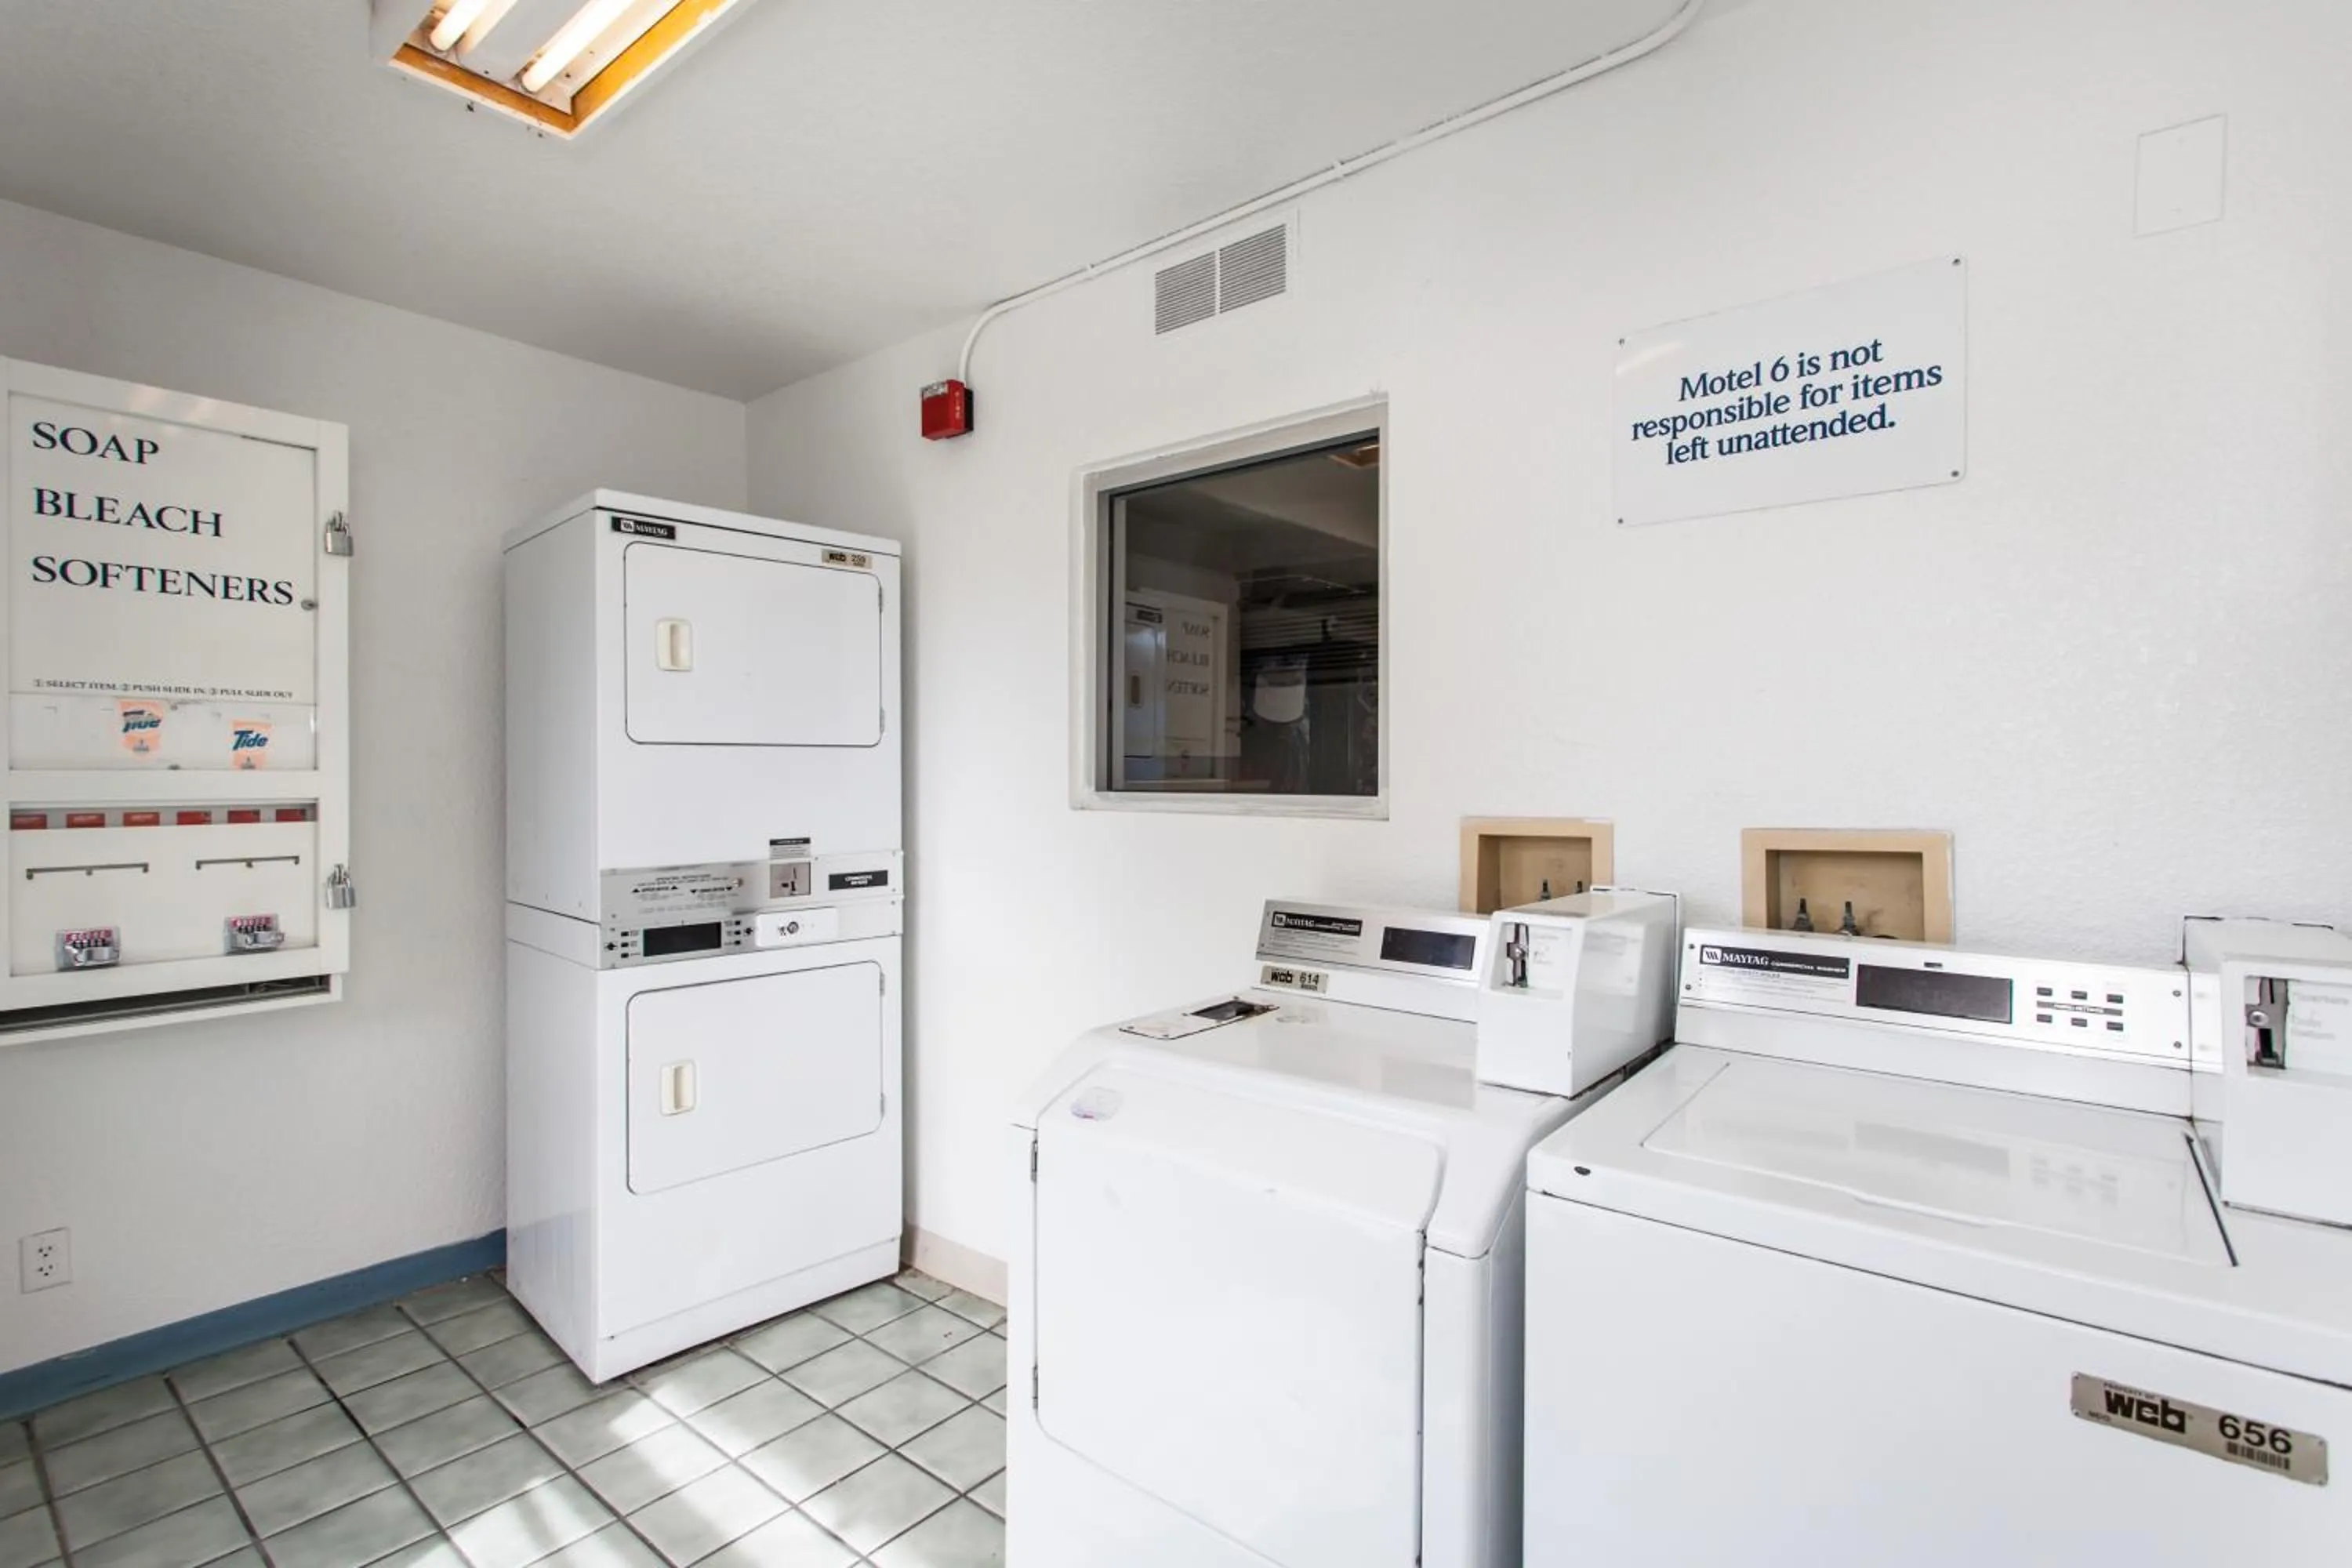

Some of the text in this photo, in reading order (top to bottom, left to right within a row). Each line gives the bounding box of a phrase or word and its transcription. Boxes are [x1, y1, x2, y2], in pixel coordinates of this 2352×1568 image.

[1678, 339, 1883, 401] Motel 6 is not
[1632, 365, 1943, 441] responsible for items
[31, 421, 160, 465] SOAP
[1665, 403, 1896, 465] left unattended.
[34, 487, 223, 538] BLEACH
[31, 555, 294, 606] SOFTENERS
[45, 679, 86, 689] SELECT
[233, 729, 269, 751] Tide
[1299, 972, 1319, 985] 614
[1722, 952, 1769, 966] MAYTAG
[2218, 1414, 2292, 1455] 656
